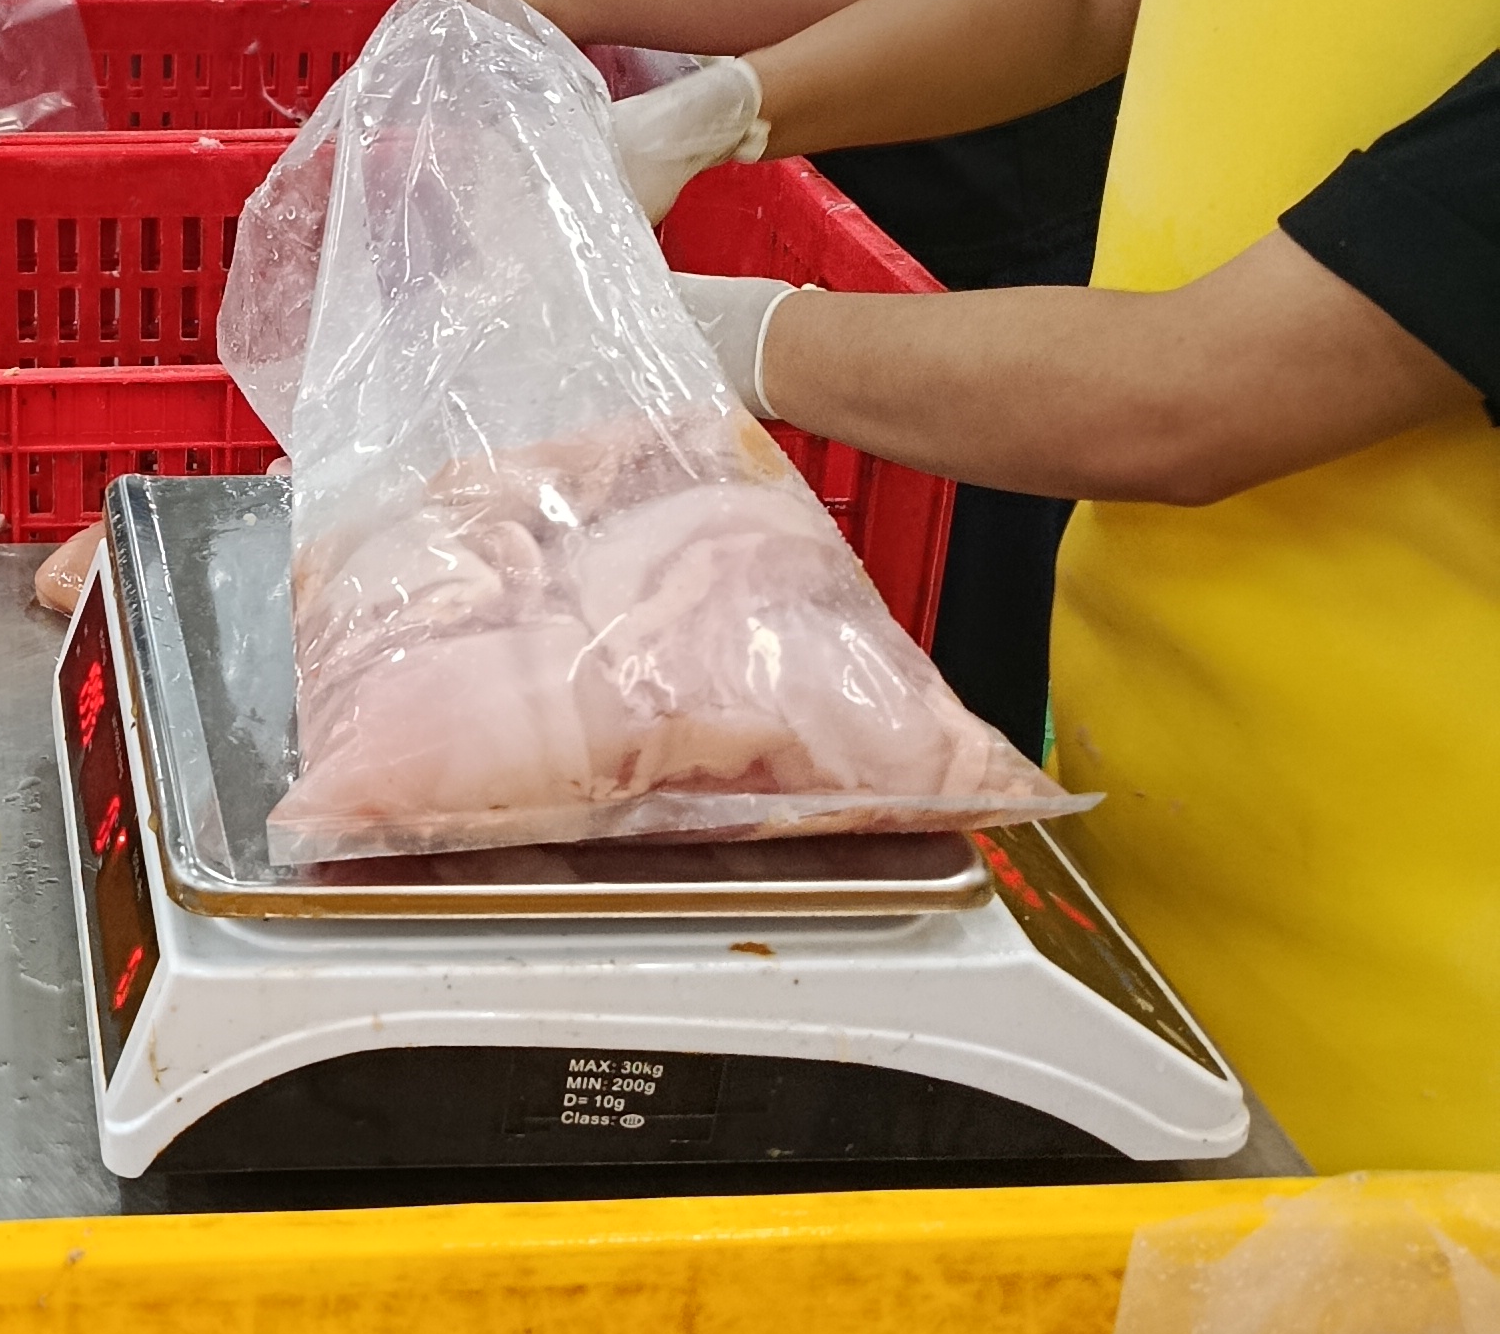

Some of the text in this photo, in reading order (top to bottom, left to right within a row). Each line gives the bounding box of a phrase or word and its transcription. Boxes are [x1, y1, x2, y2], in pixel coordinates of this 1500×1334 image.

[569, 1059, 664, 1078] MAX: 30kg
[566, 1076, 656, 1095] MIN: 200g
[563, 1093, 625, 1111] D= 10g
[560, 1111, 616, 1126] Class:
